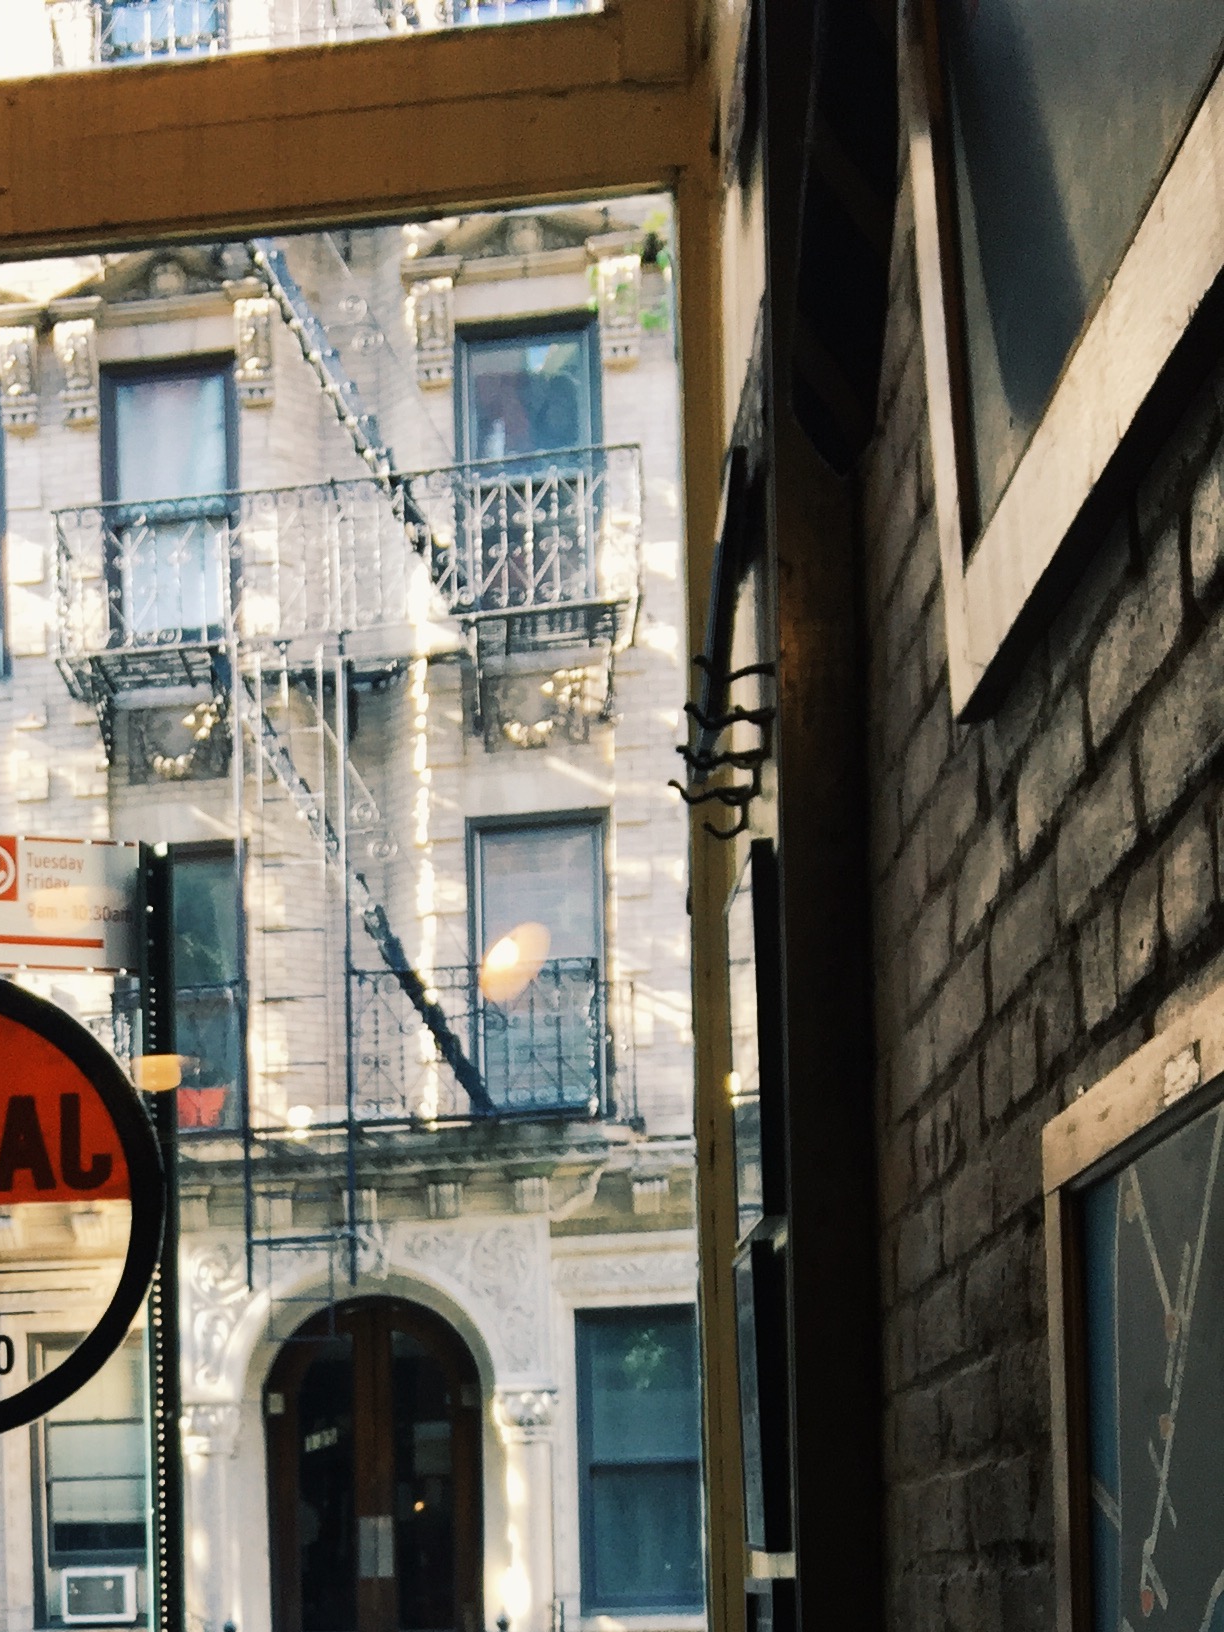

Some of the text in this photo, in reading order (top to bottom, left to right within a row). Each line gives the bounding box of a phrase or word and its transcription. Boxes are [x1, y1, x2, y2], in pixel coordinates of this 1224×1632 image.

[27, 852, 84, 872] Tuesday
[27, 873, 70, 892] Friday
[27, 902, 58, 919] 9am
